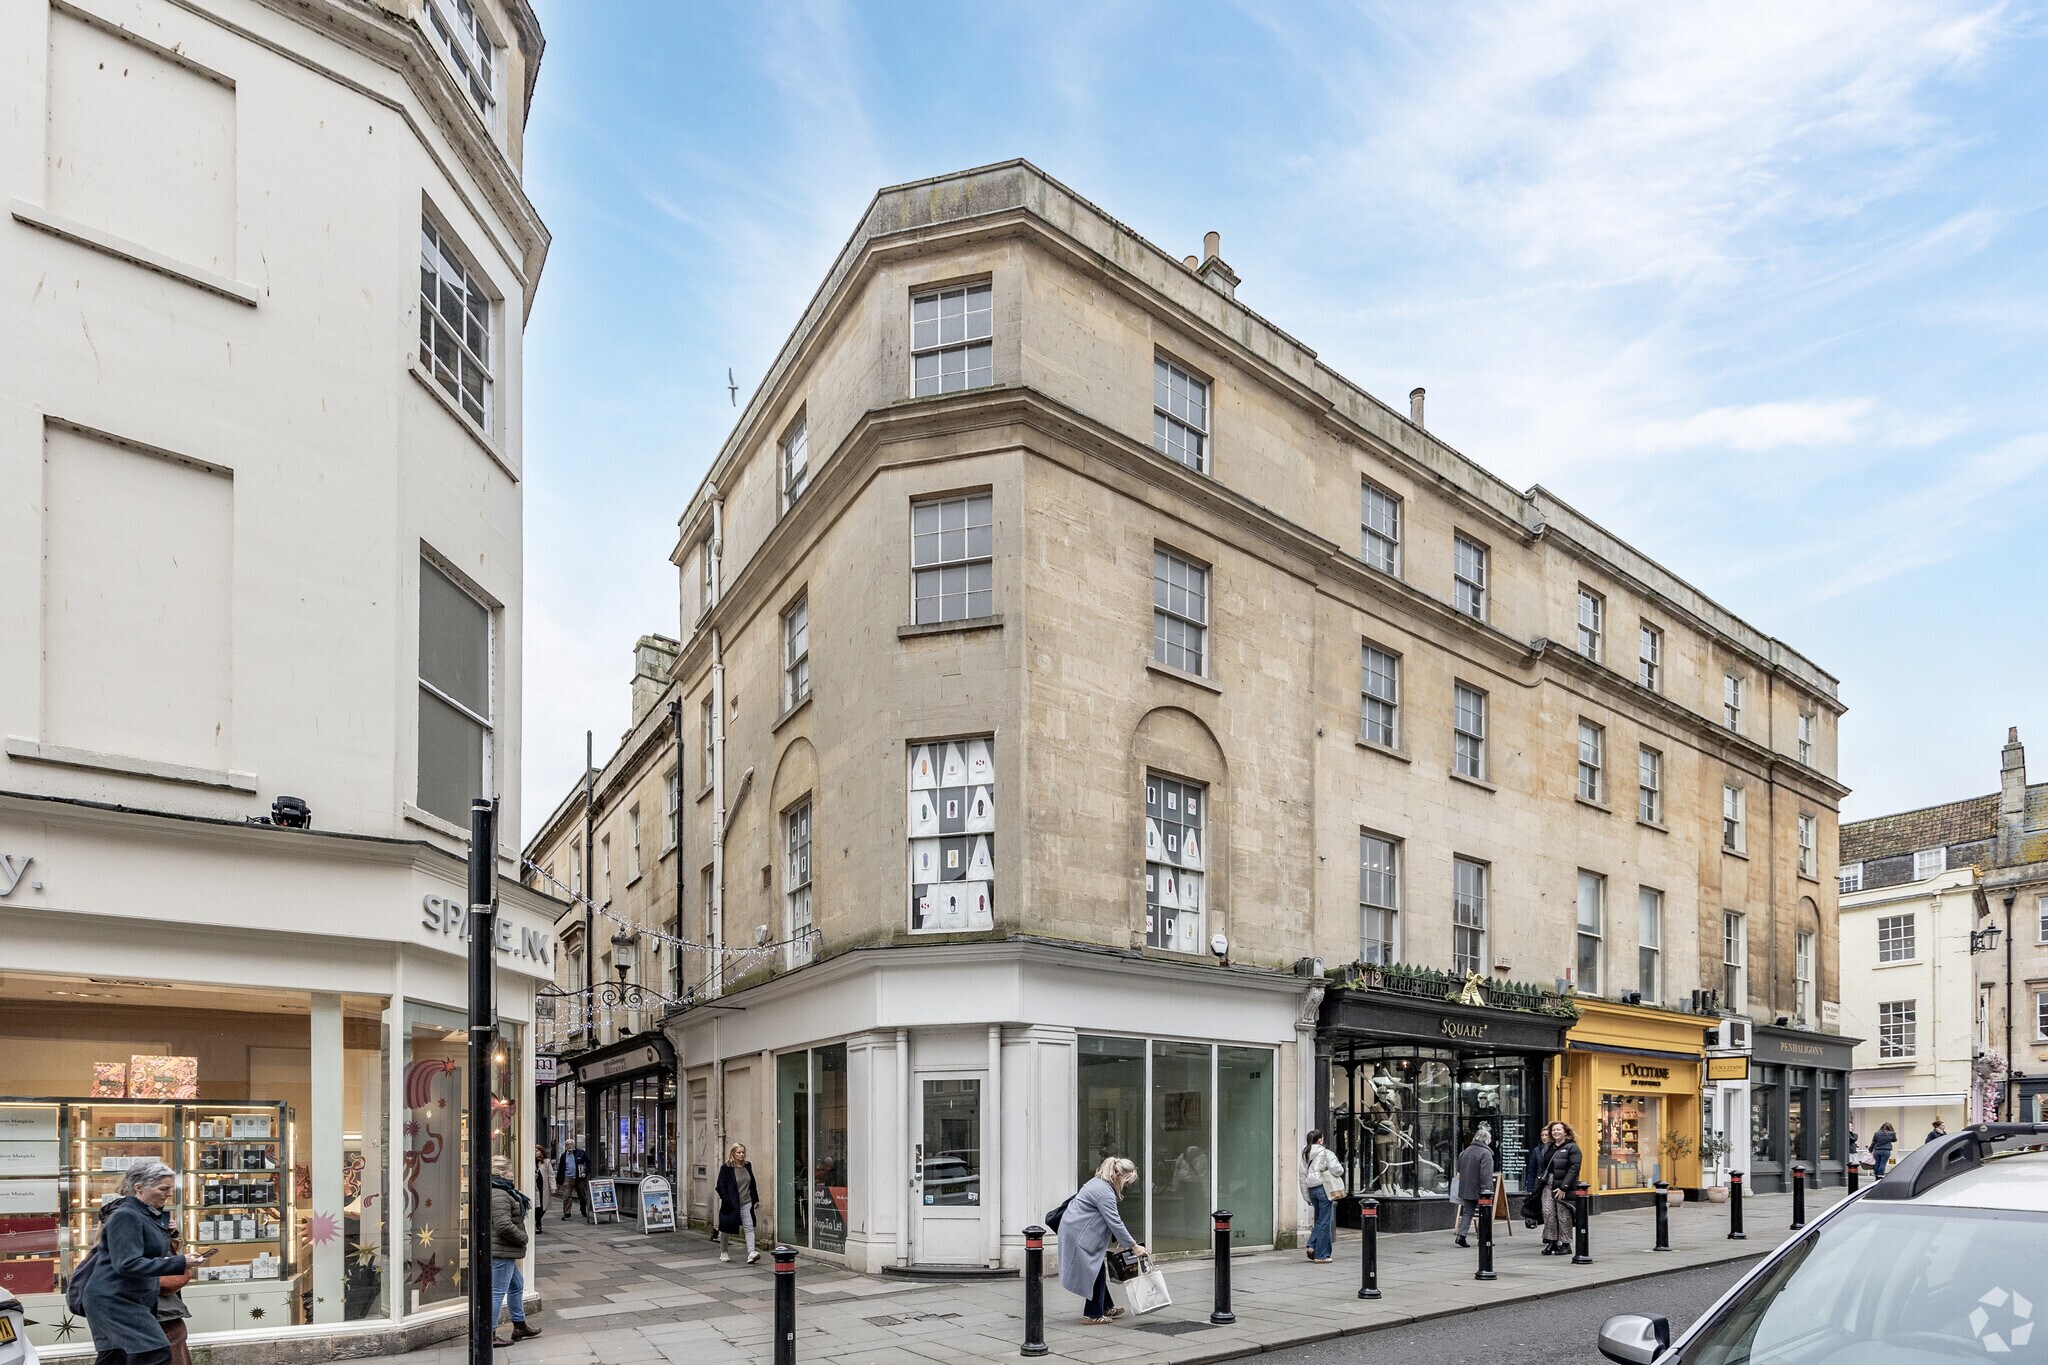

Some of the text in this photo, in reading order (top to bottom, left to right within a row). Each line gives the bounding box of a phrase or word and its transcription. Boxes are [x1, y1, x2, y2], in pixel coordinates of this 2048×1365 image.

[422, 894, 550, 964] SPE.NK
[1780, 1042, 1824, 1056] PENHALIGON'S
[1621, 1062, 1670, 1079] L'OCCITANE
[833, 1220, 842, 1231] Let
